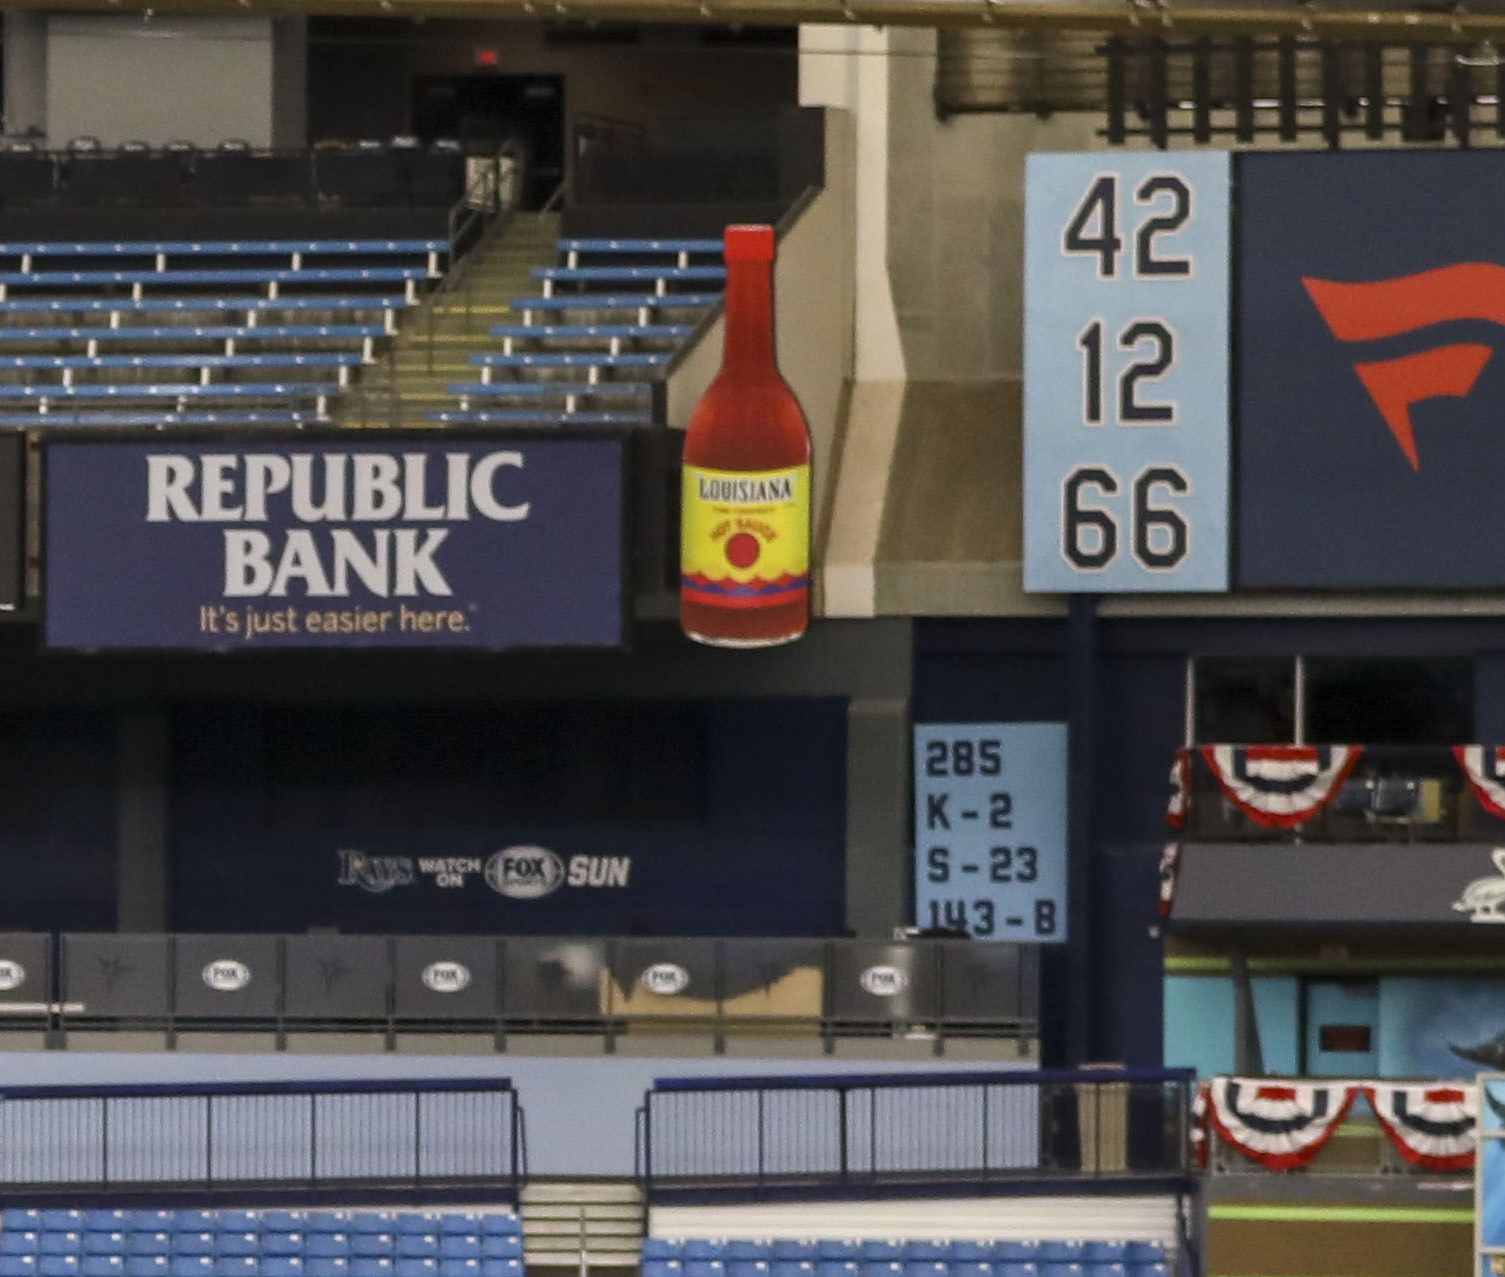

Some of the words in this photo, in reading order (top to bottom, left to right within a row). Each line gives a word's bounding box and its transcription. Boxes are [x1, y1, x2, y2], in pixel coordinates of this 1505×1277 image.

[1063, 175, 1191, 279] 42
[1077, 319, 1176, 425] 12
[146, 452, 529, 522] REPUBLIC
[698, 477, 793, 502] LOUISIANA
[1060, 466, 1188, 570] 66
[224, 529, 451, 597] BANK
[200, 606, 239, 633] It's
[245, 607, 298, 640] just
[305, 607, 392, 633] easier
[400, 605, 471, 633] here.
[926, 740, 1001, 777] 285
[419, 858, 481, 874] WATCH
[436, 874, 463, 888] ON
[502, 859, 546, 876] FOX
[568, 856, 630, 887] SUN
